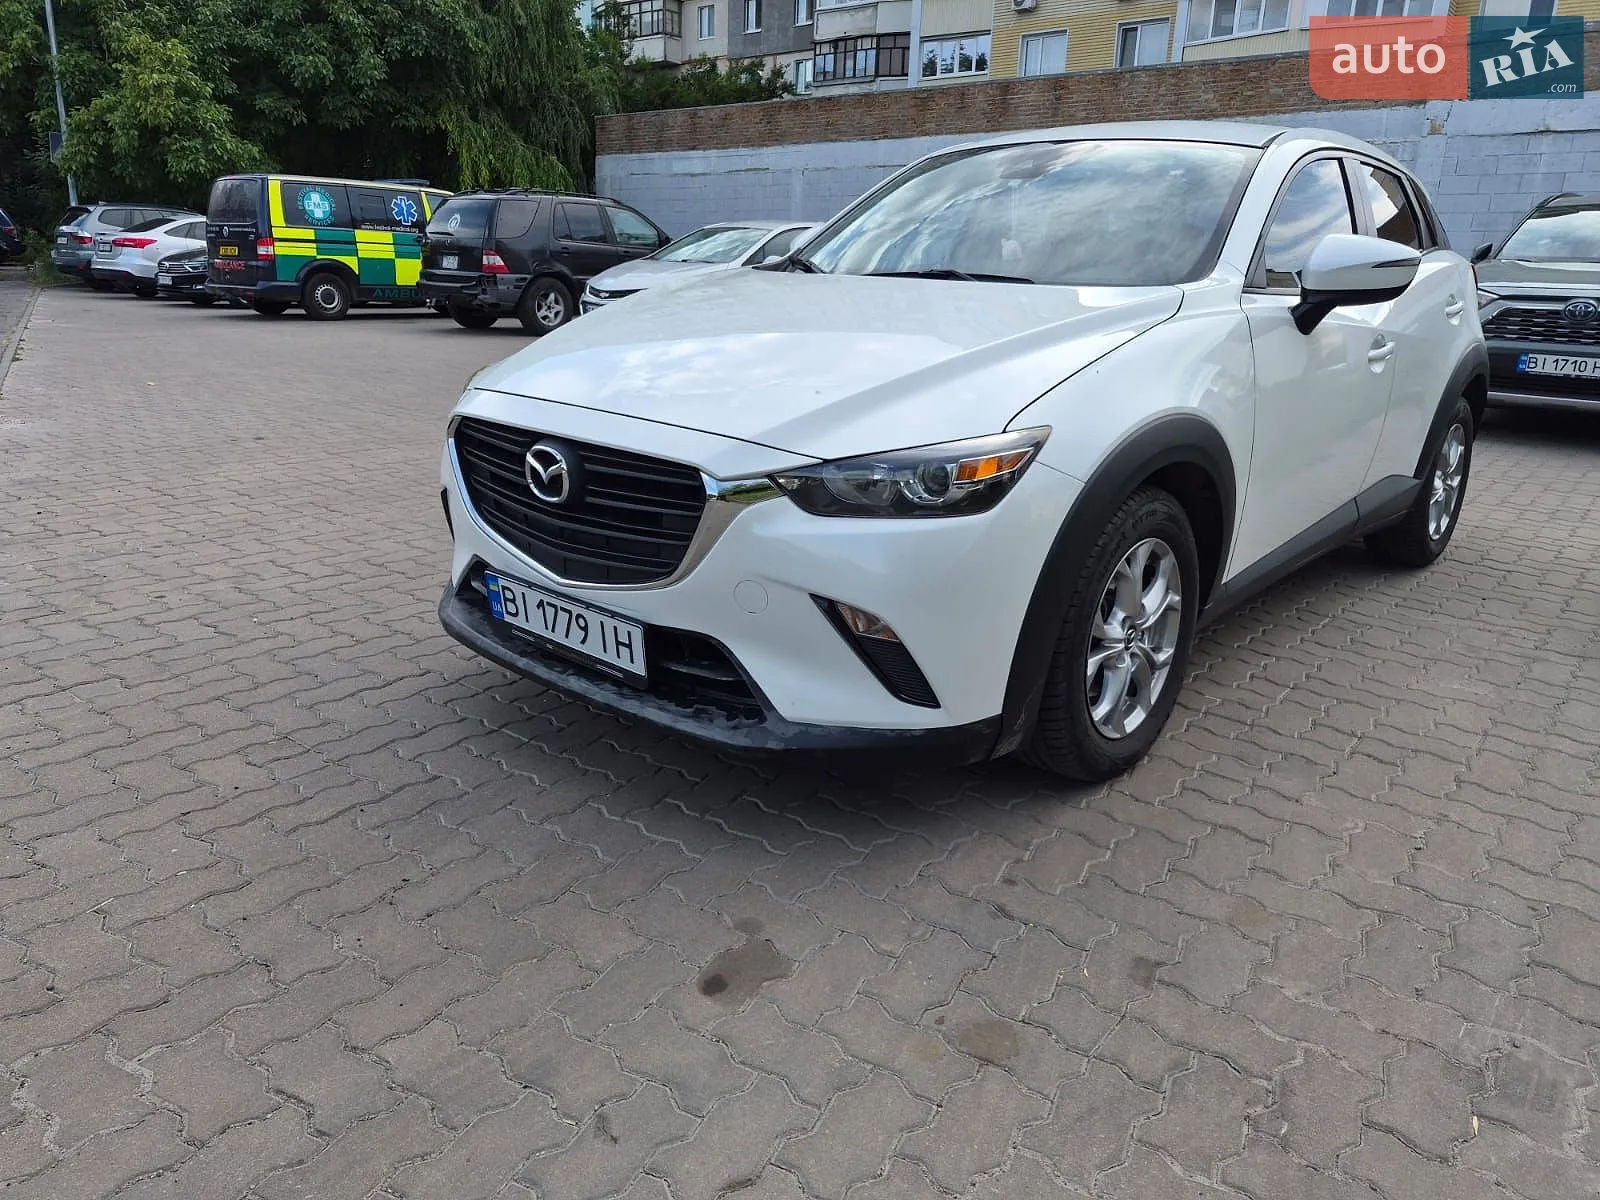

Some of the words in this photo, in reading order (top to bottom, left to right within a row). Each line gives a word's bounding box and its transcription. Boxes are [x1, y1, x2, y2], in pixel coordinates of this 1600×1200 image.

[306, 201, 328, 210] FMS
[1527, 357, 1548, 370] BI
[1552, 358, 1588, 373] 1710
[501, 585, 530, 623] BI
[536, 598, 589, 645] 1779
[600, 620, 634, 665] IH
